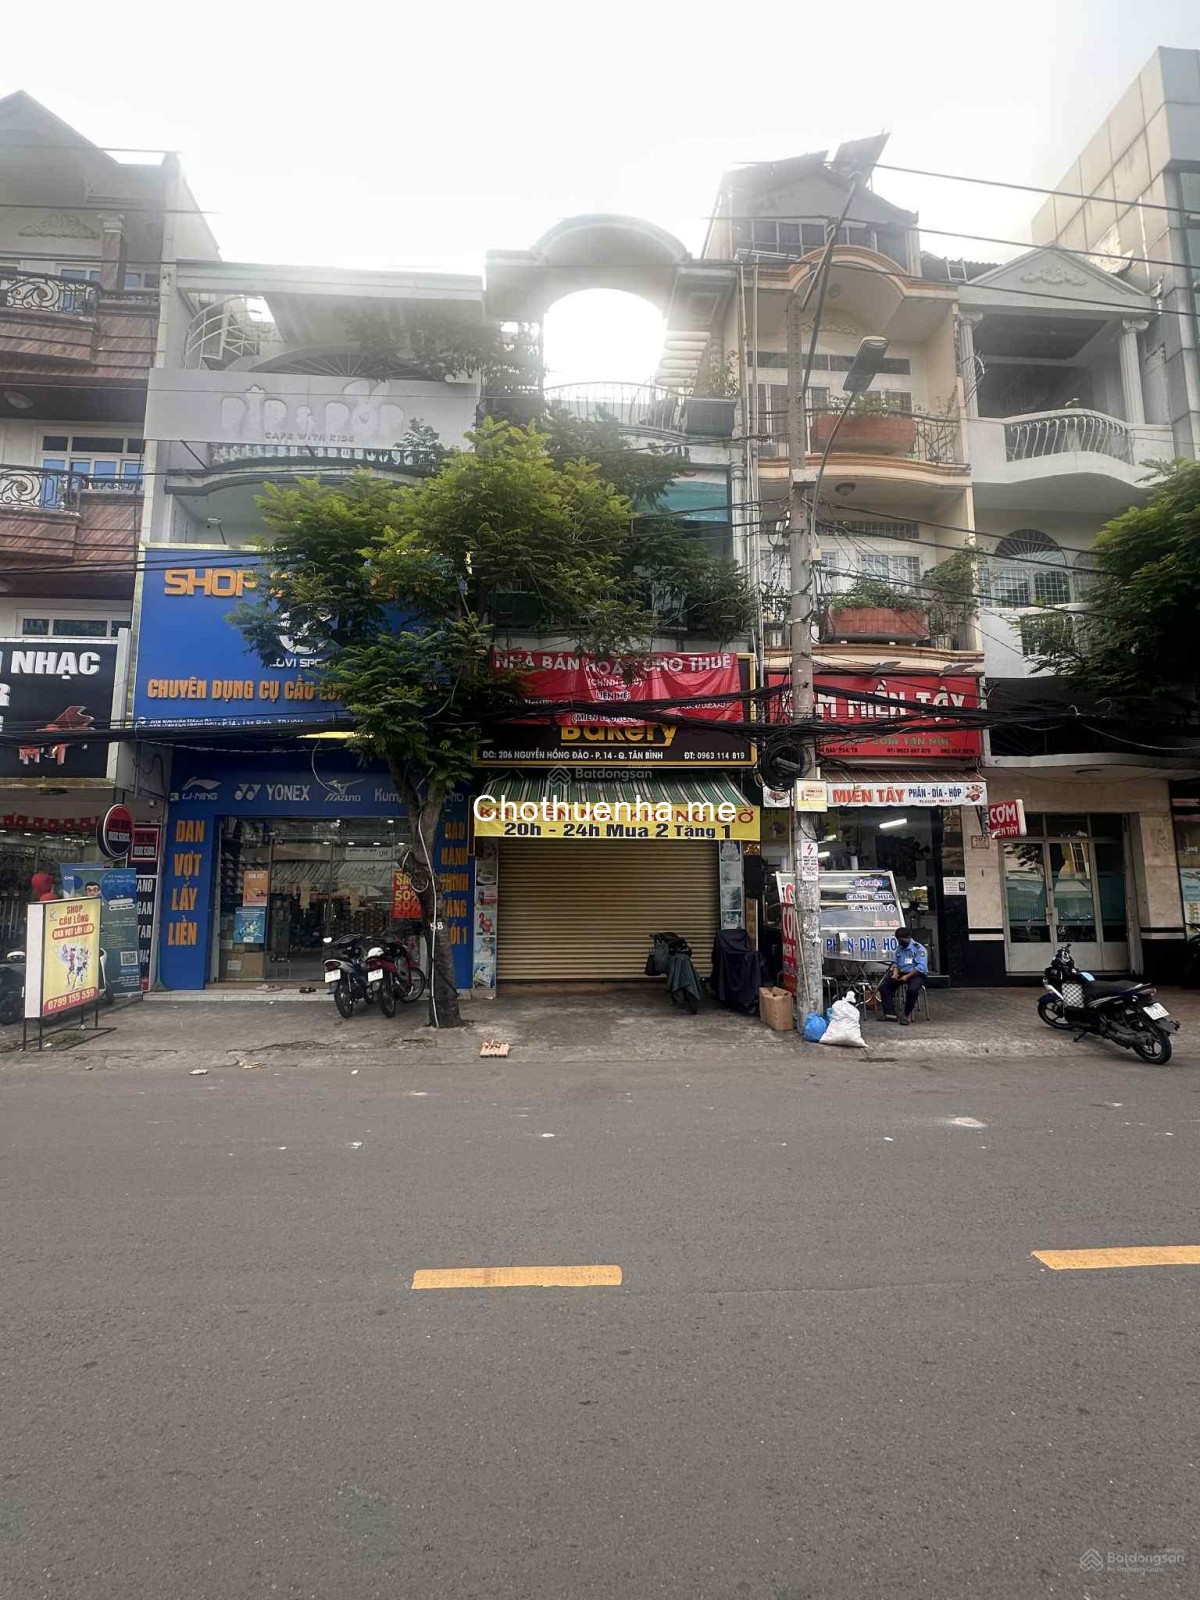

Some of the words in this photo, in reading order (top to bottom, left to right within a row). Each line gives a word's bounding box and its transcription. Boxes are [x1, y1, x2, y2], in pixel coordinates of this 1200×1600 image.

[164, 568, 258, 597] SHOP
[11, 651, 101, 680] NHẠC
[542, 653, 580, 671] BÁN
[688, 653, 732, 671] THUÊ
[147, 676, 207, 700] CHUYÊN
[212, 680, 255, 704] DỤNG
[259, 680, 280, 703] CỤ
[499, 751, 512, 759] 206
[514, 747, 545, 759] NGUYỄN
[547, 747, 570, 759] HỒNG
[572, 749, 589, 759] ĐÀO
[629, 750, 643, 759] TÂN
[645, 750, 663, 760] BÌNH
[684, 752, 696, 760] ĐT:
[697, 752, 715, 760] 0963
[717, 752, 730, 760] 114
[732, 752, 745, 760] 819
[267, 784, 311, 801] YONEX
[876, 786, 906, 803] TÂY
[989, 803, 1016, 824] CƠM
[504, 822, 542, 836] 20h
[563, 823, 600, 837] 24h
[606, 824, 649, 838] Mua
[655, 823, 669, 838] 2
[674, 824, 716, 839] Tặng
[720, 824, 731, 839] 1
[174, 853, 203, 877] VỢT
[137, 879, 153, 893] ANO
[171, 883, 198, 911] LẤY
[67, 905, 83, 914] SHOP
[167, 914, 198, 946] LIỀN
[48, 995, 67, 1009] 0799
[68, 991, 80, 1004] 155
